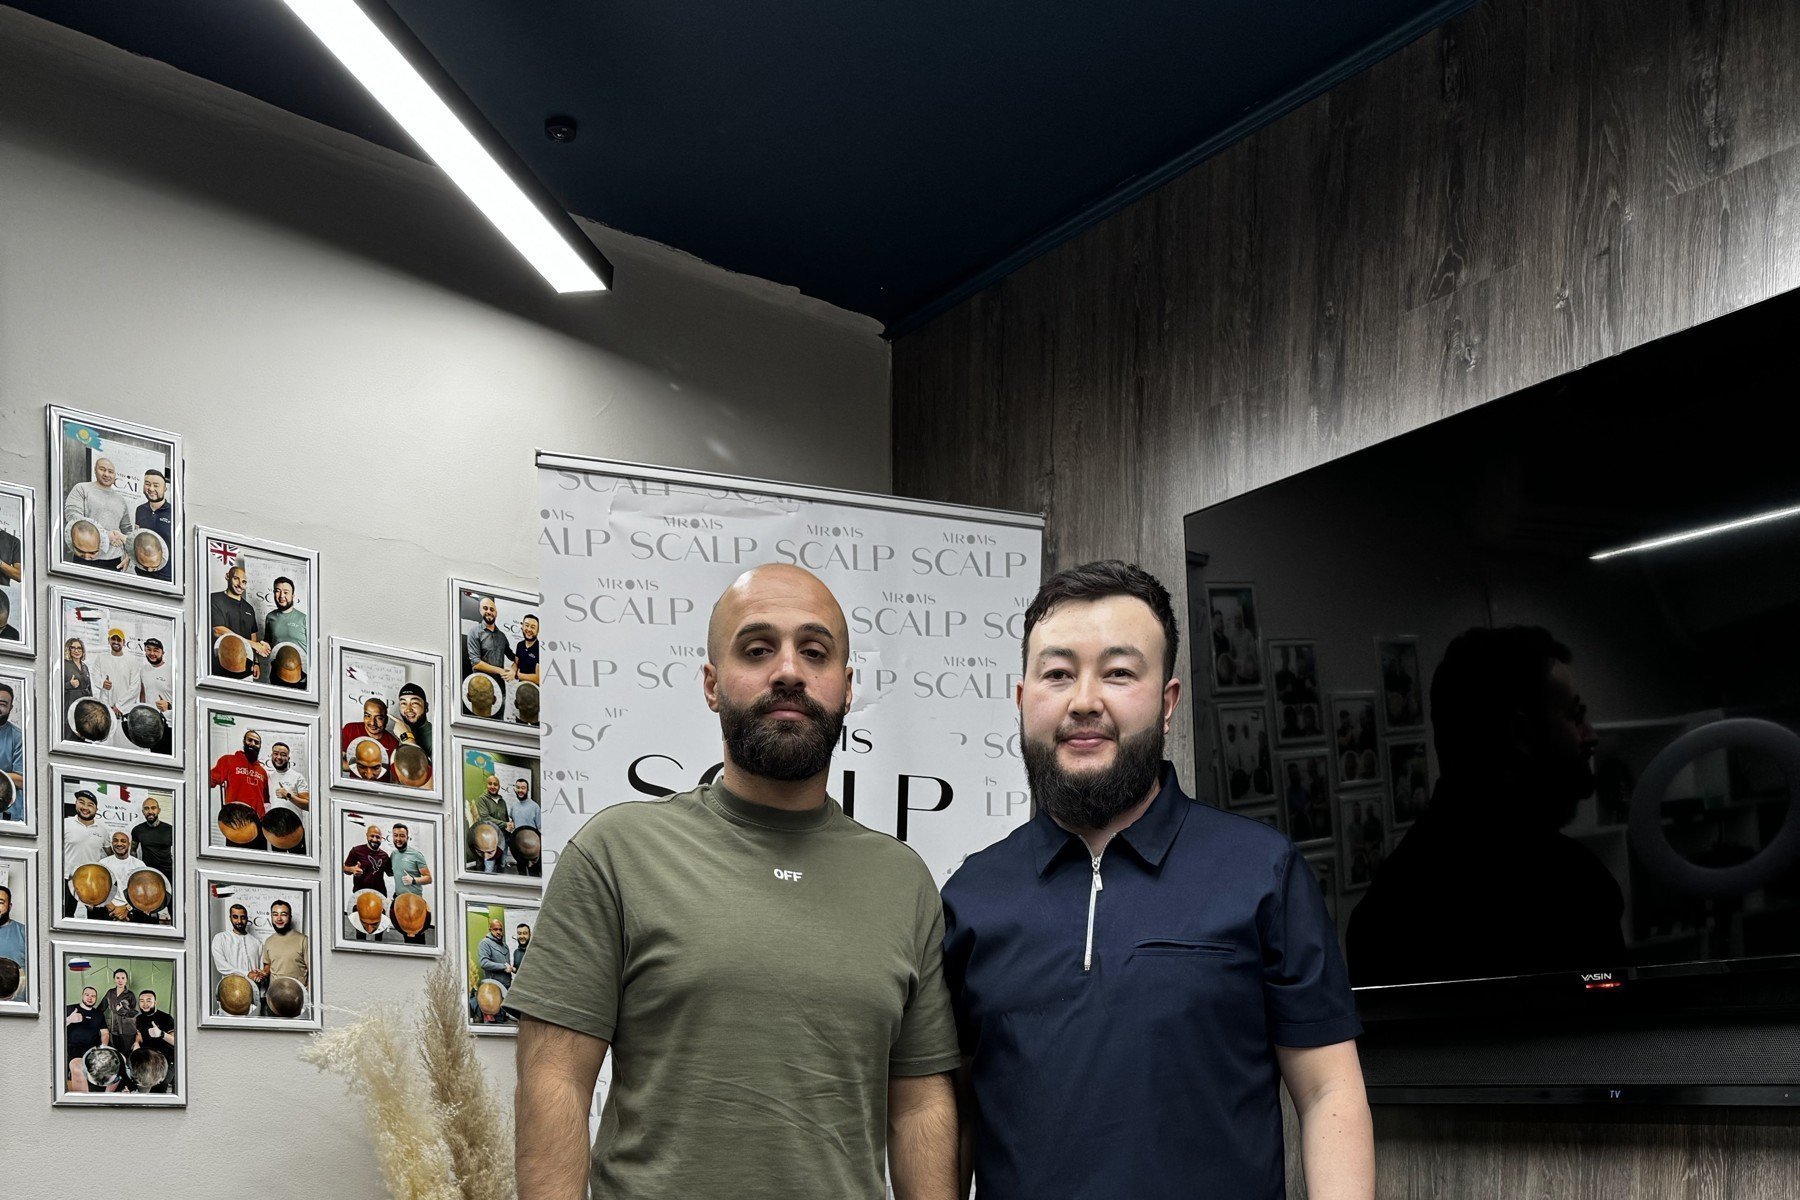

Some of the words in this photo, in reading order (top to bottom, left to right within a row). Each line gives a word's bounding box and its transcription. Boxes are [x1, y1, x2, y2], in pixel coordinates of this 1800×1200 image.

[538, 526, 611, 557] ALP
[629, 530, 758, 564] SCALP
[775, 539, 895, 572] SCALP
[911, 547, 1027, 578] SCALP
[563, 593, 694, 626] SCALP
[851, 606, 967, 638] SCALP
[541, 658, 618, 688] ALP
[773, 868, 803, 882] OFF
[1609, 1090, 1621, 1099] TV
